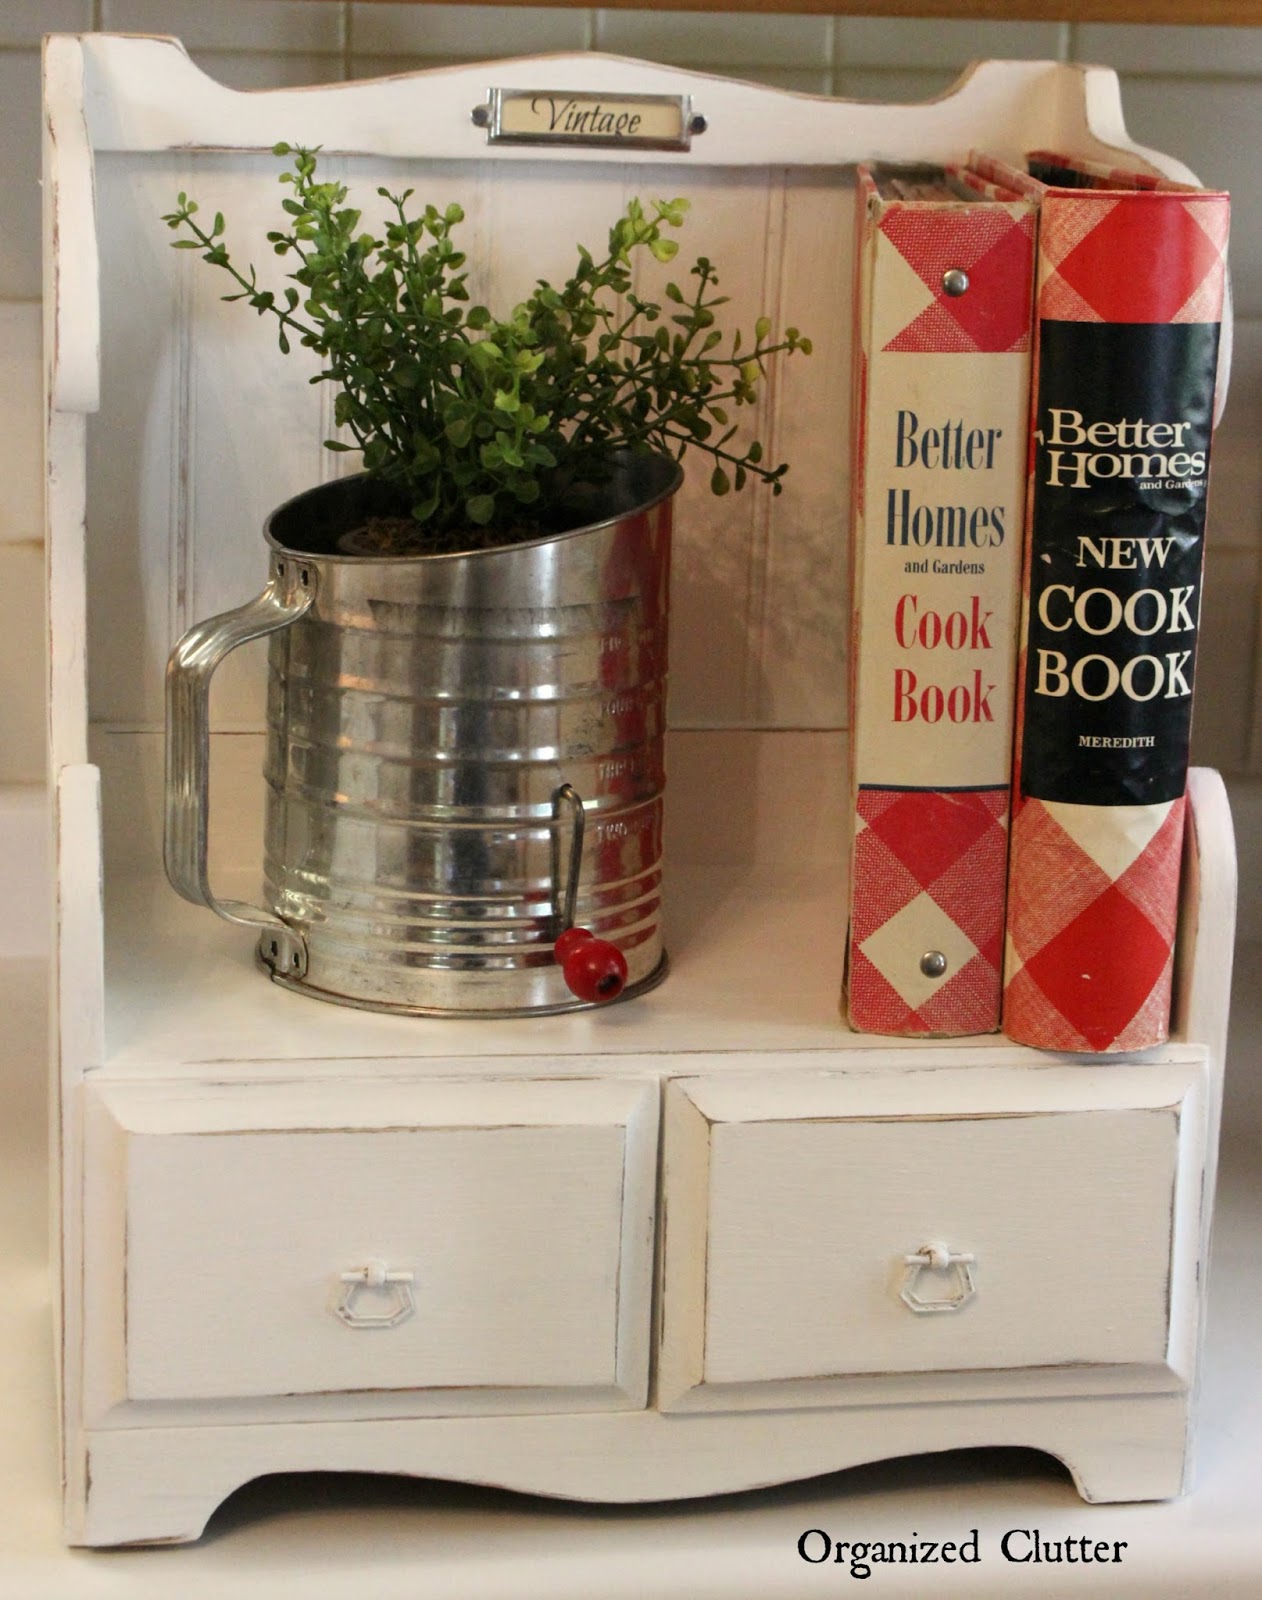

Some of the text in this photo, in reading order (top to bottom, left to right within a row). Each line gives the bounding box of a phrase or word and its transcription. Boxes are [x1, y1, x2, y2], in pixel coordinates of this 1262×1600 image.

[531, 97, 641, 137] Vintage
[895, 409, 1003, 470] Better
[1047, 408, 1191, 449] Better
[1046, 450, 1206, 488] Homes
[1139, 479, 1162, 490] and
[885, 488, 1006, 548] Homes
[904, 559, 985, 575] and Gardens
[1076, 536, 1176, 570] NEW
[894, 593, 994, 650] Cook
[1038, 584, 1195, 637] COOK
[1034, 648, 1192, 702] BOOK
[891, 668, 997, 724] Book
[1078, 735, 1156, 749] MEREDITH
